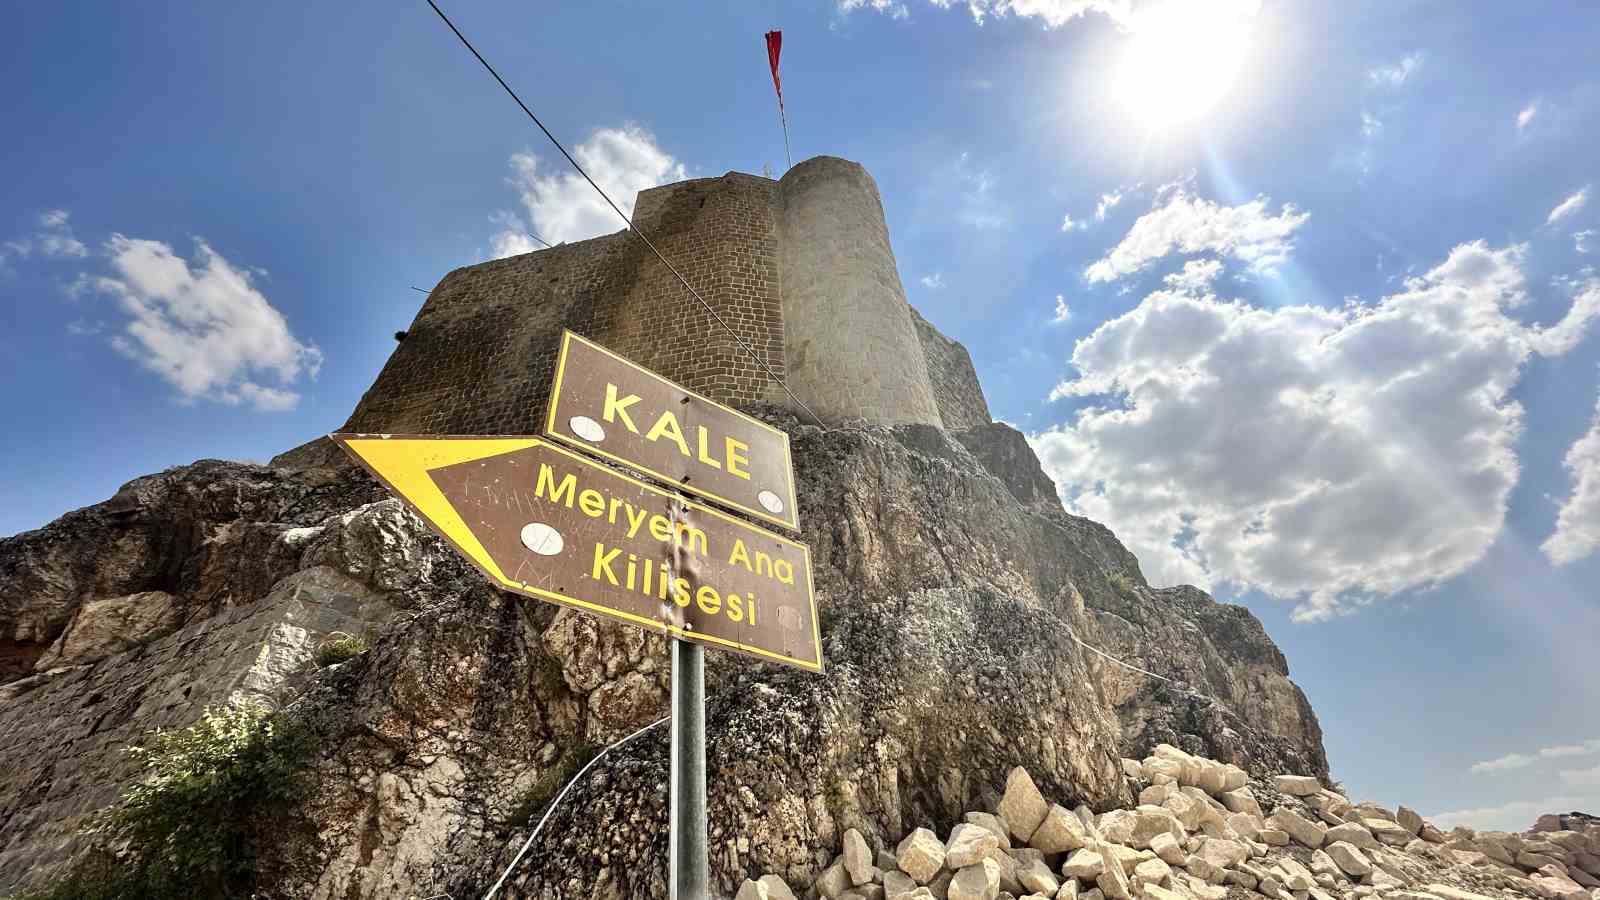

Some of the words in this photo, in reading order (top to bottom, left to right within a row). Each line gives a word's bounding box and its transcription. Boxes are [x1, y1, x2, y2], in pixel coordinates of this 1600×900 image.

[602, 382, 751, 480] KALE
[535, 463, 708, 558] Meryem
[729, 539, 795, 585] Ana
[592, 543, 757, 626] Kilisesi
